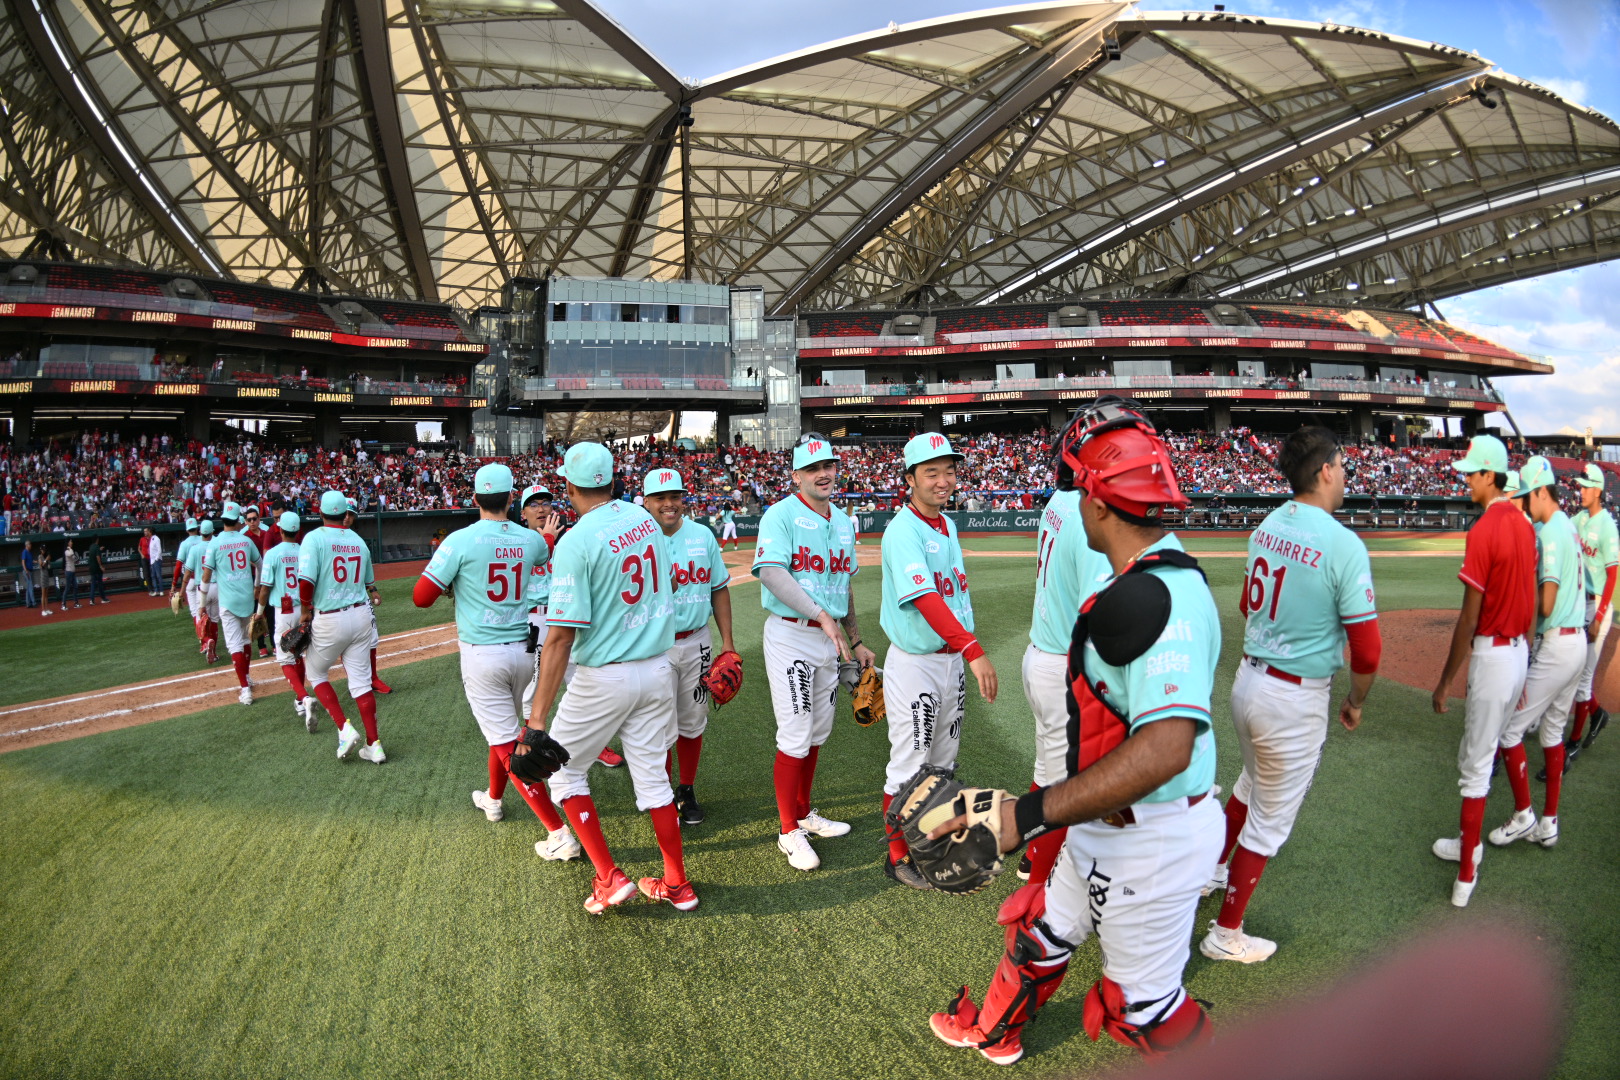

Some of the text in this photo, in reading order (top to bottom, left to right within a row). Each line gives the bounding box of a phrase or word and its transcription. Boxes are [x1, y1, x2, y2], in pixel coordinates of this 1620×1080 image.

[51, 308, 95, 318] ¡GANAMOS!
[132, 312, 176, 322] ¡GANAMOS!
[212, 319, 256, 330] ¡GANAMOS!
[292, 329, 332, 340] ¡GANAMOS!
[368, 338, 409, 348] ¡GANAMOS!
[444, 342, 484, 352] ¡GANAMOS!
[980, 342, 1020, 351] ¡GANAMOS!
[1055, 340, 1096, 349] ¡GANAMOS!
[1128, 339, 1168, 347] ¡GANAMOS!
[1201, 338, 1239, 347] ¡GANAMOS!
[1334, 343, 1366, 351] ¡GANAMOS!
[832, 348, 872, 356] ¡GANAMOS!
[906, 346, 946, 356] ¡GANAMOS!
[70, 381, 116, 392] ¡GANAMOS!
[155, 384, 200, 395] ¡GANAMOS!
[237, 388, 280, 398] ¡GANAMOS!
[314, 393, 354, 402] ¡GANAMOS!
[982, 392, 1023, 401] ¡GANAMOS!
[1058, 390, 1098, 400] ¡GANAMOS!
[1132, 390, 1172, 399] ¡GANAMOS!
[1206, 389, 1243, 398] ¡GANAMOS!
[1275, 392, 1310, 400] ¡GANAMOS!
[390, 396, 432, 405] ¡GANAMOS!
[834, 396, 874, 406] ¡GANAMOS!
[332, 544, 360, 553] ROMERO
[496, 547, 524, 559] CANO
[227, 550, 246, 572] 19
[333, 556, 361, 584] 67
[621, 543, 658, 606] 31
[487, 562, 523, 602] 51
[1248, 556, 1287, 623] 61
[788, 675, 799, 714] caliente.mx
